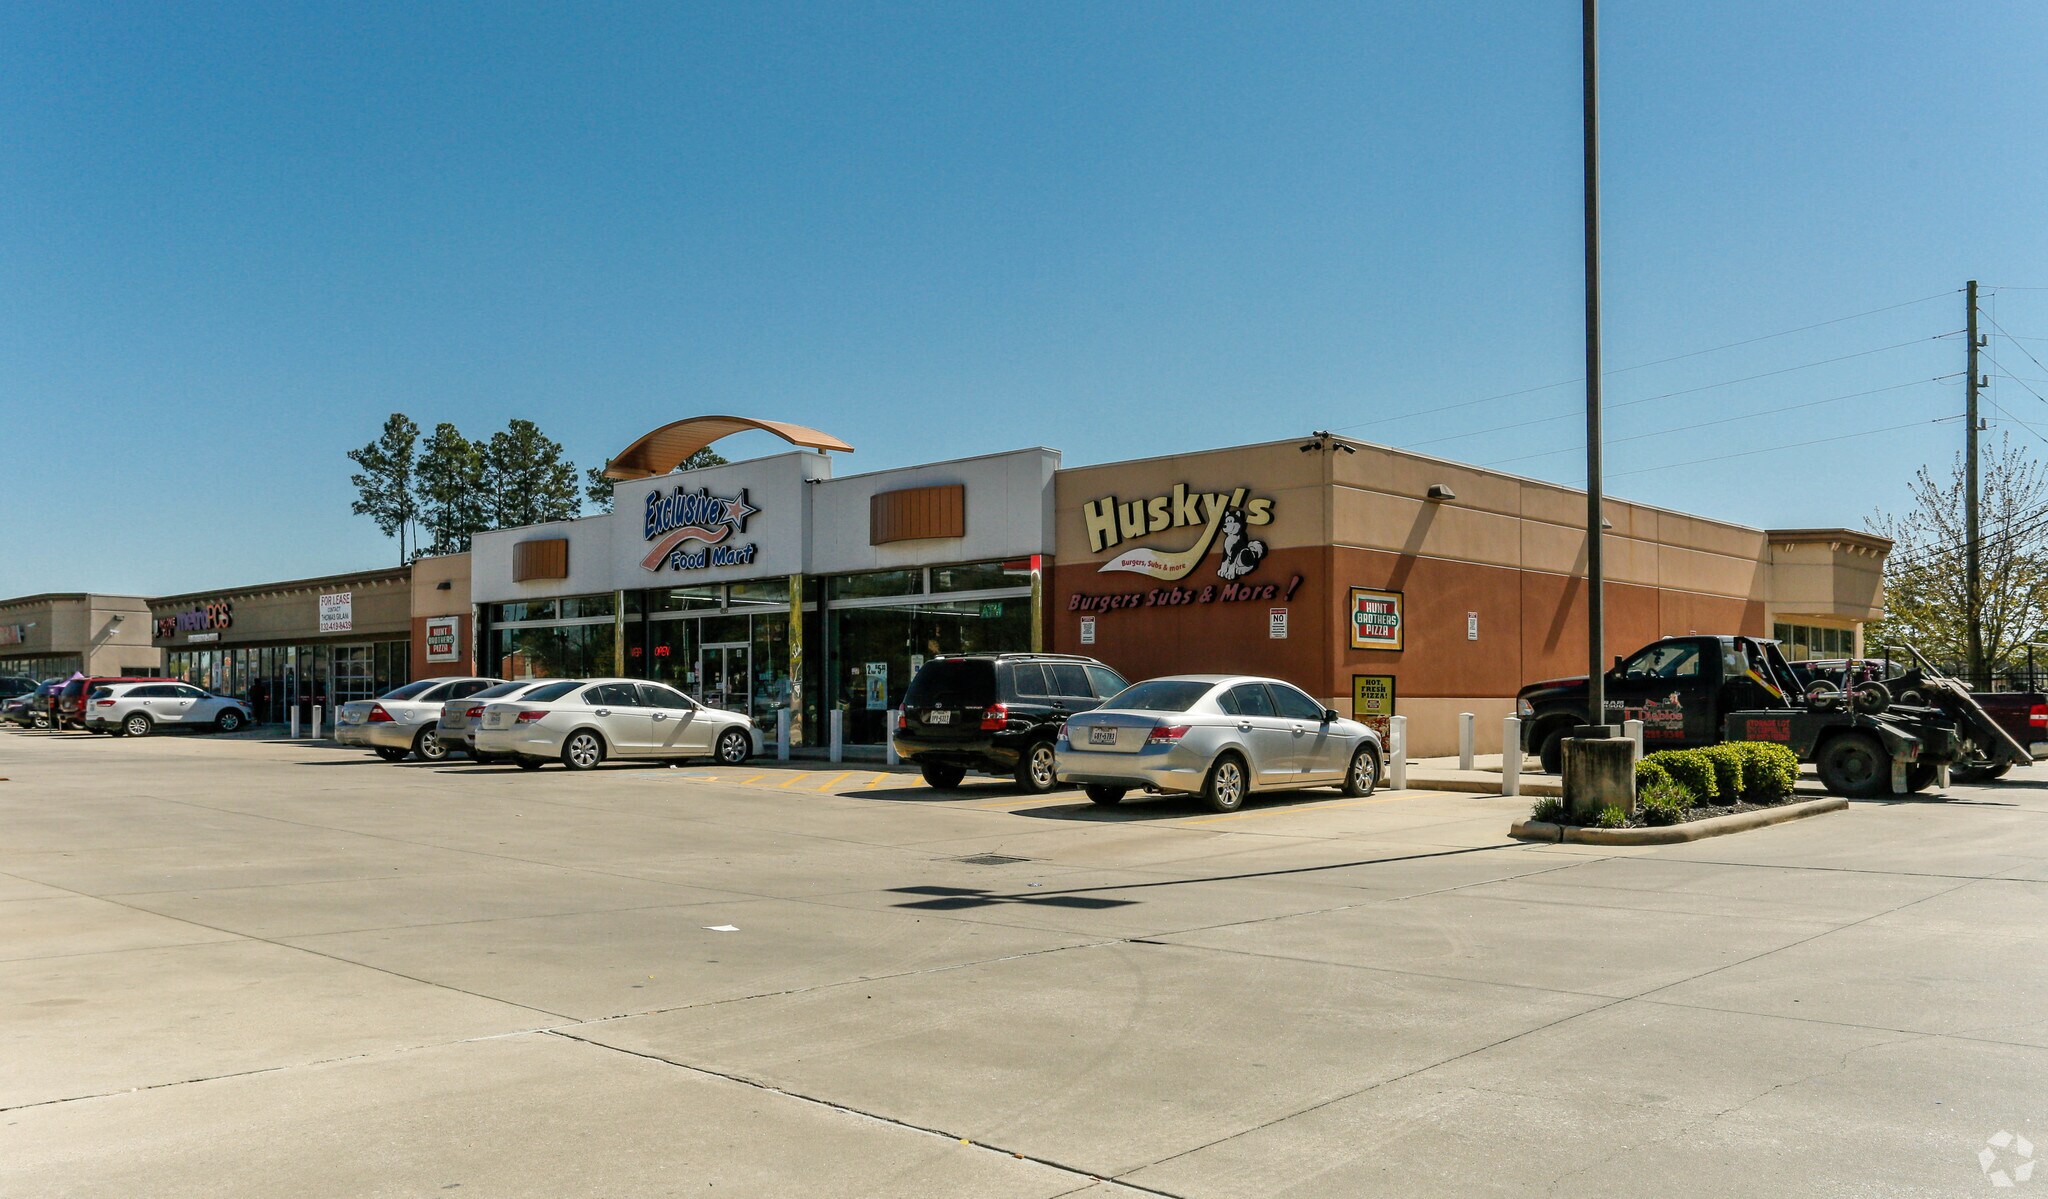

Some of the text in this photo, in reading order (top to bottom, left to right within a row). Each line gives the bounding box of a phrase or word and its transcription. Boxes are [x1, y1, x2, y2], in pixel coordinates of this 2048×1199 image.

[643, 486, 721, 541] Exclusive
[1083, 483, 1273, 553] Husky's
[670, 543, 753, 571] Food Mart
[1121, 559, 1147, 567] Burgers,
[1147, 560, 1162, 570] Subs
[1169, 563, 1186, 572] more
[320, 593, 350, 606] FOR LEASE
[1068, 594, 1141, 613] Burgers
[1145, 587, 1193, 607] Subs
[1199, 585, 1213, 603] &
[1219, 583, 1275, 601] More
[1366, 601, 1388, 614] HUNT
[175, 603, 229, 631] metroPCS
[1273, 614, 1284, 622] NO
[1357, 612, 1397, 626] BROTHERS
[1366, 624, 1389, 637] PIZZA
[433, 644, 448, 653] PIZZA
[654, 645, 670, 657] OPEN
[1361, 685, 1387, 693] FRESH
[1365, 679, 1384, 687] HOT,
